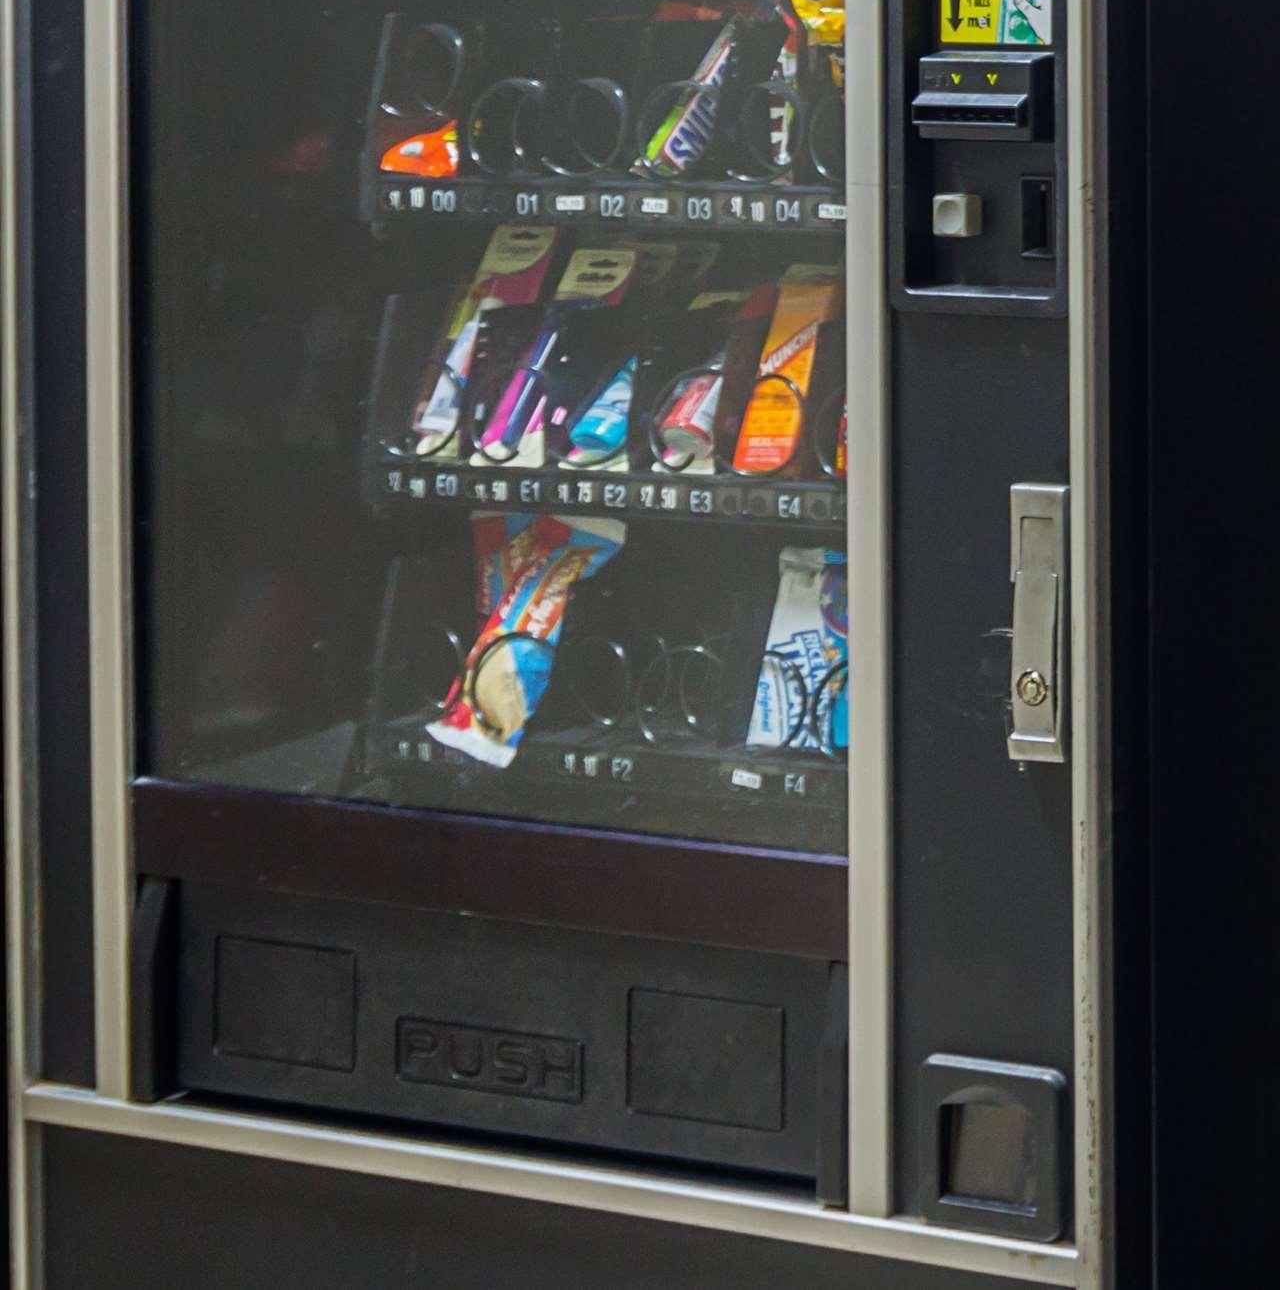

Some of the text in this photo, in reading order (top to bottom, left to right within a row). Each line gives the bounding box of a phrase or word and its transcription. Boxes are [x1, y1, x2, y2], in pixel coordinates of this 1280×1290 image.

[968, 14, 991, 29] mei
[776, 199, 800, 222] D4
[435, 473, 458, 496] E0
[520, 479, 540, 502] E1
[603, 484, 627, 506] E2
[690, 490, 713, 513] E3
[778, 494, 801, 518] E4
[612, 757, 633, 781] F2
[784, 774, 806, 798] F4
[404, 1034, 578, 1093] PUSH
